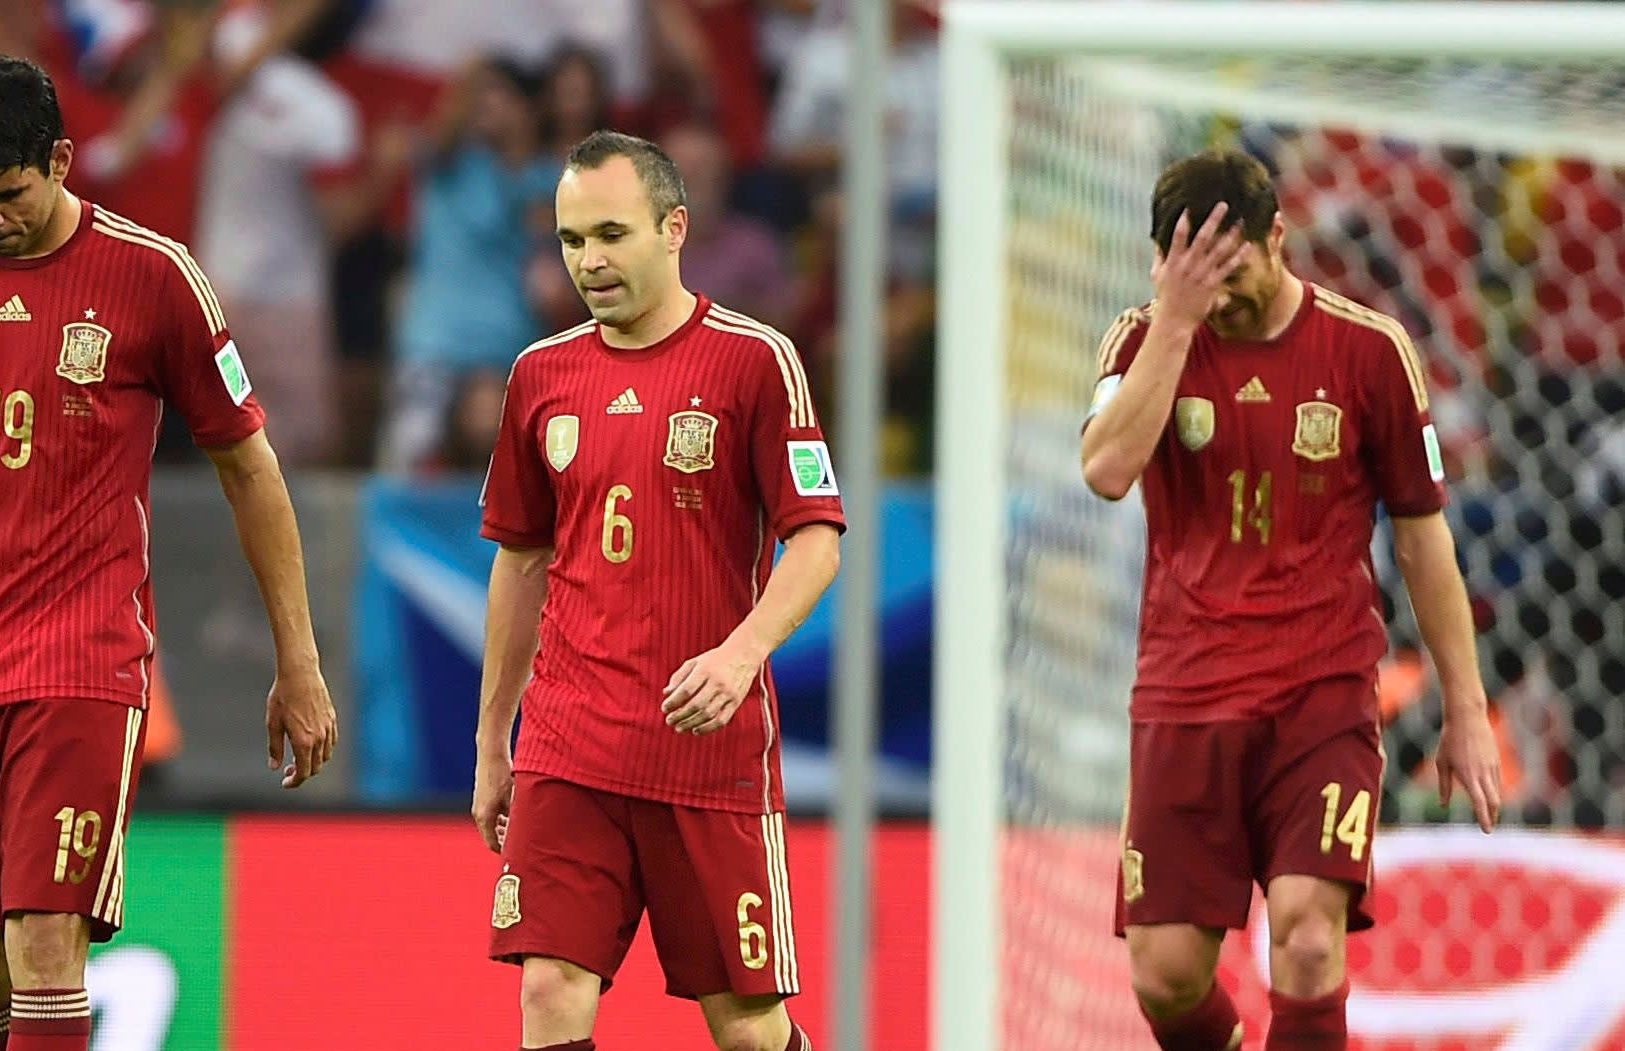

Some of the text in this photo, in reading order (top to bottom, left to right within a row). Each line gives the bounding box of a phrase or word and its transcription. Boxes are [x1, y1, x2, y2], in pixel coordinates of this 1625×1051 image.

[605, 404, 644, 415] adidas
[601, 484, 633, 564] 6
[1227, 469, 1272, 545] 14
[54, 806, 102, 885] 19
[1320, 783, 1371, 862] 14
[736, 892, 767, 970] 6
